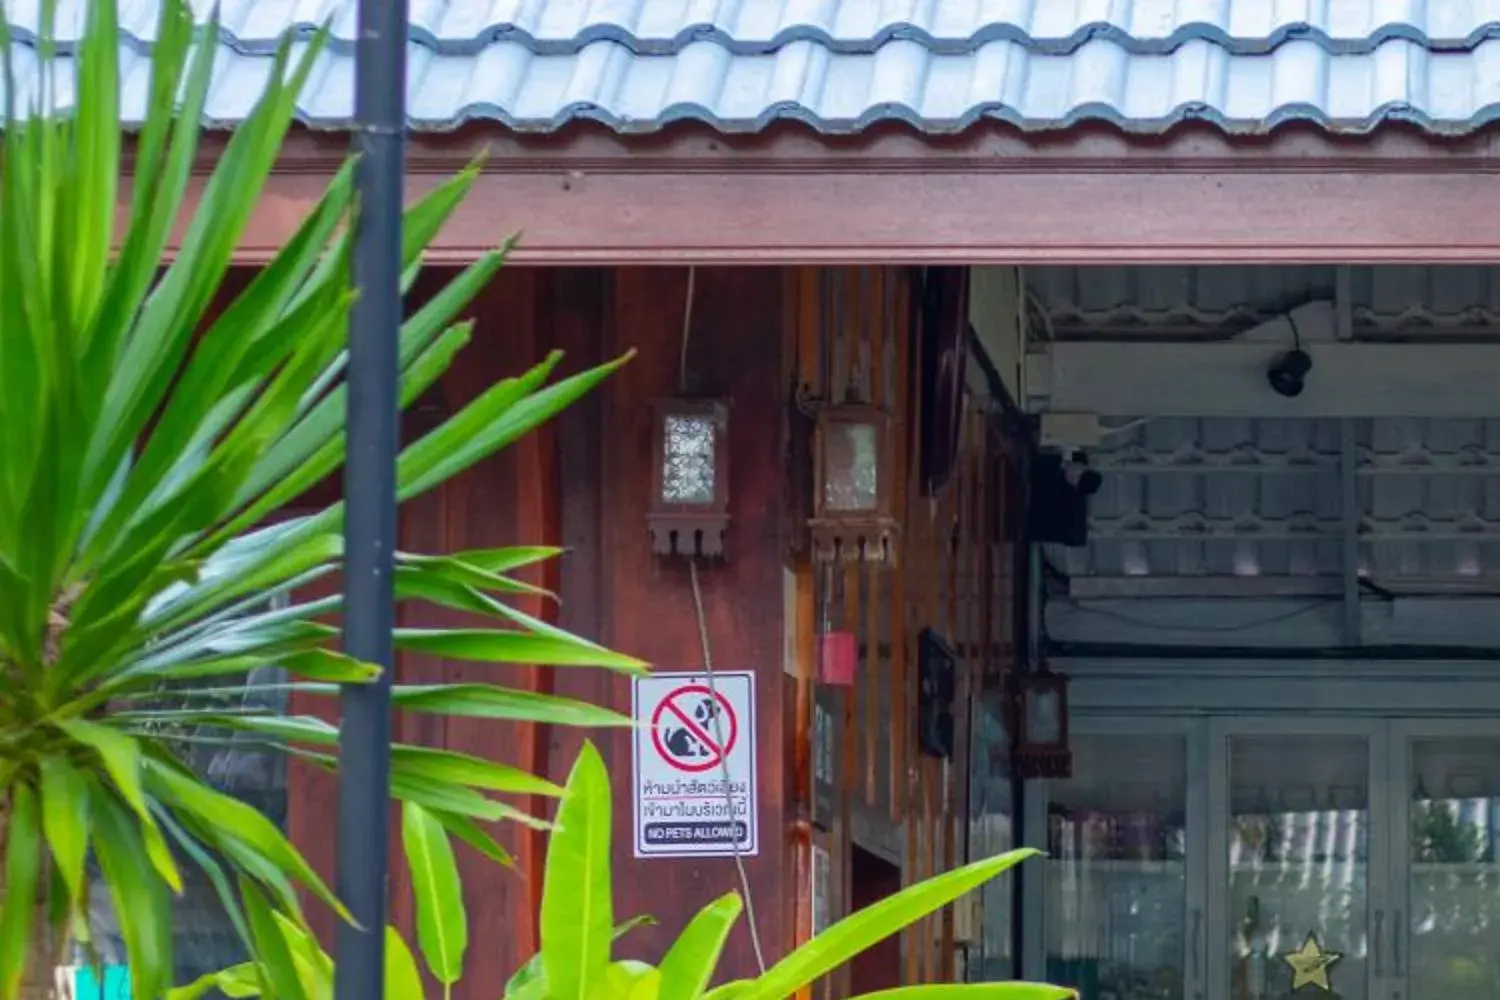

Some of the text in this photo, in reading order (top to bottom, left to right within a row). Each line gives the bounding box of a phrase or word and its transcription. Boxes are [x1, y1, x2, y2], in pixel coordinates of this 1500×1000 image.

[647, 827, 743, 839] NO PETS ALLOWED
